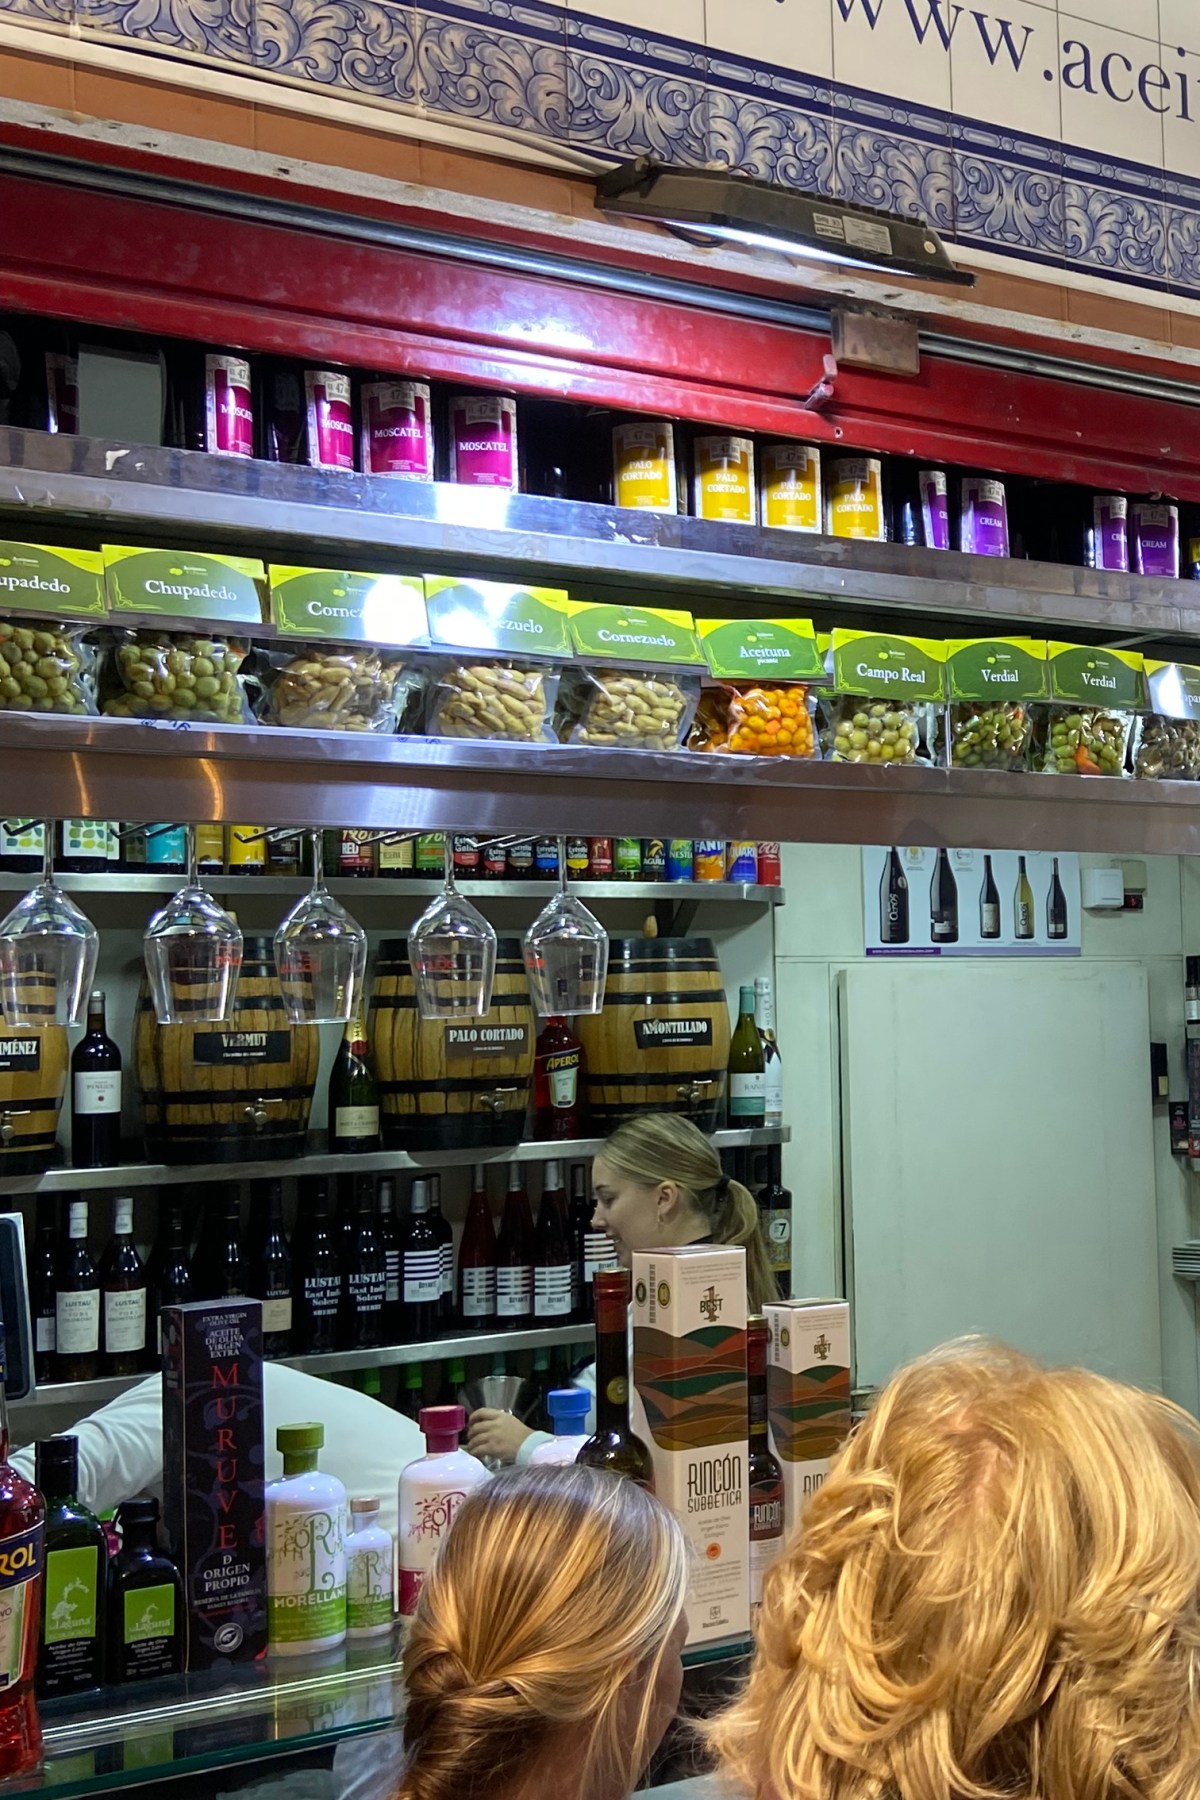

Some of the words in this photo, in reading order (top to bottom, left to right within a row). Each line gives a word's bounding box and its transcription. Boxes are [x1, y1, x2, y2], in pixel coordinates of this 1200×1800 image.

[374, 427, 424, 440] MOSCATEL
[459, 440, 509, 453] MOSCATEL
[629, 461, 653, 470] PALO
[622, 471, 663, 481] CORTADO
[716, 472, 738, 483] PALO
[707, 484, 746, 494] CORTADO
[781, 481, 803, 490] PALO
[772, 491, 812, 501] CORTADO
[844, 493, 866, 503] PALO
[836, 503, 874, 514] CORTADO
[1141, 539, 1167, 549] CREAM
[145, 579, 238, 601] Chupadedo
[597, 628, 677, 648] Cornezuelo
[739, 645, 792, 660] Aceituna
[856, 663, 899, 683] Campo
[901, 666, 926, 684] Real
[981, 669, 1020, 683] Verdial
[1081, 672, 1116, 689] Verdial
[642, 1021, 708, 1036] AMONTILLADO
[221, 1033, 270, 1048] VERMUT
[448, 1029, 478, 1043] PALO
[480, 1028, 525, 1043] CORTADO
[209, 1327, 241, 1338] ACEITE
[205, 1337, 217, 1346] DE
[218, 1334, 245, 1344] OLIVA
[208, 1341, 242, 1351] VIRGEN
[210, 1349, 240, 1358] EXTRA
[687, 1452, 742, 1498] RINCÓN
[203, 1562, 251, 1580] ORIGEN
[205, 1574, 250, 1592] PROPIO
